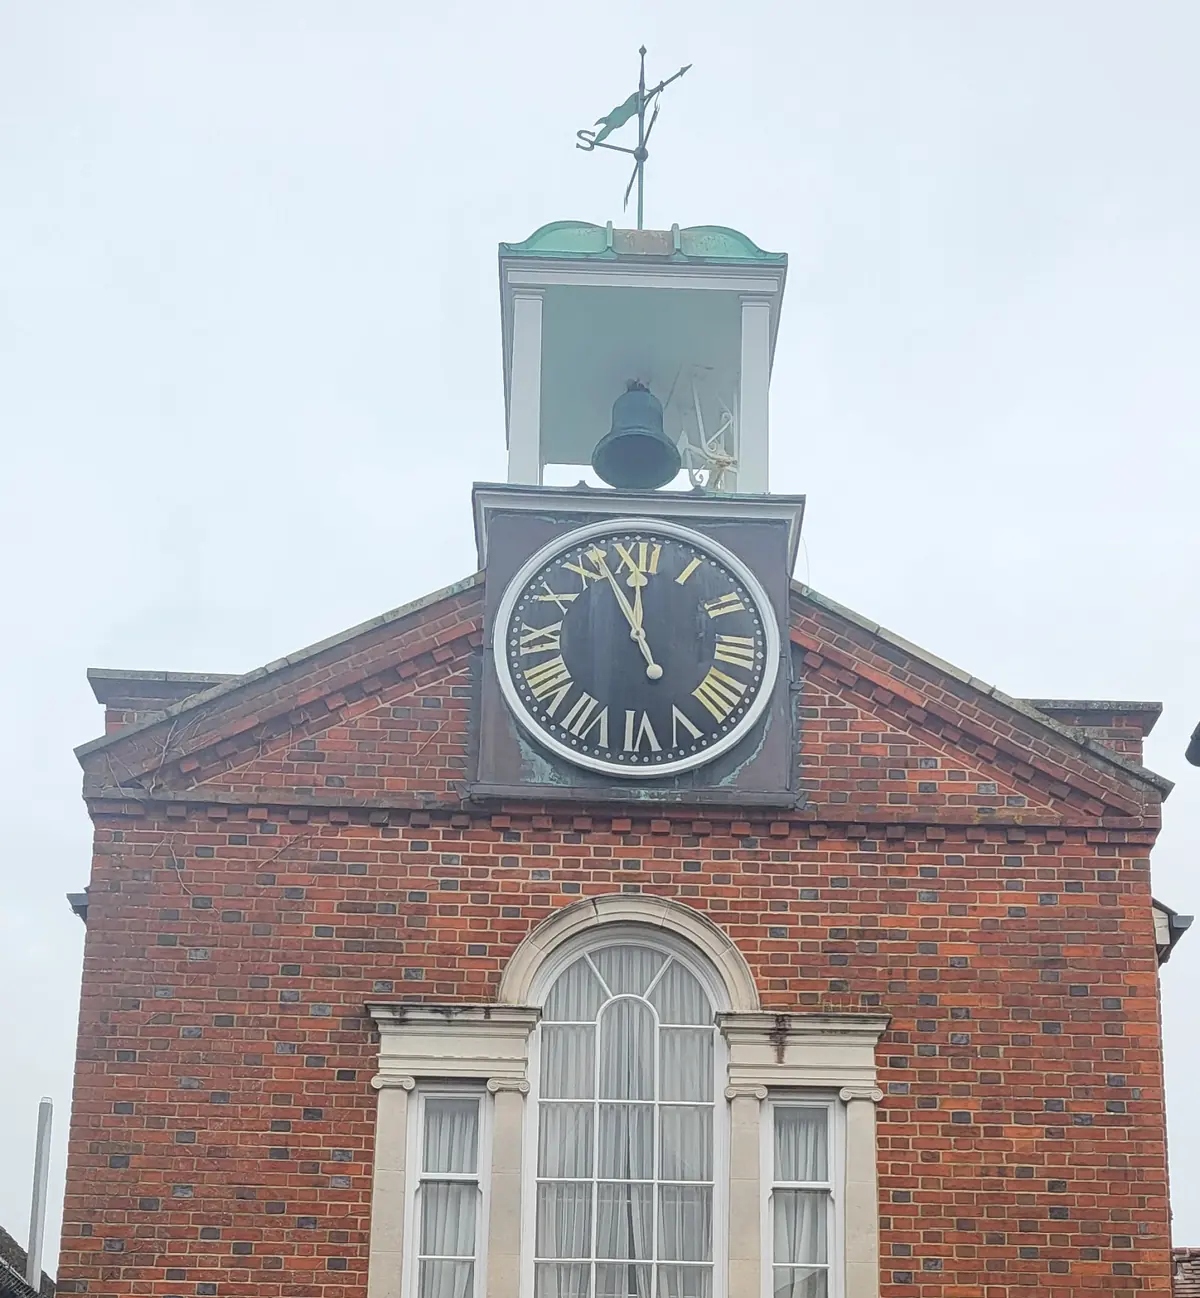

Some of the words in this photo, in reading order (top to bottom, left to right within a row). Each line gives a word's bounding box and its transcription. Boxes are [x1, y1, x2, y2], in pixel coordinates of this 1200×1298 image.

[575, 130, 595, 152] S
[612, 542, 662, 575] XII
[674, 557, 702, 585] I
[531, 581, 580, 615] X
[704, 592, 746, 619] II
[714, 633, 755, 671] III
[523, 653, 574, 717] VIII
[691, 666, 748, 724] IIII
[559, 691, 609, 748] VII
[623, 710, 662, 752] VI
[672, 703, 704, 748] V
